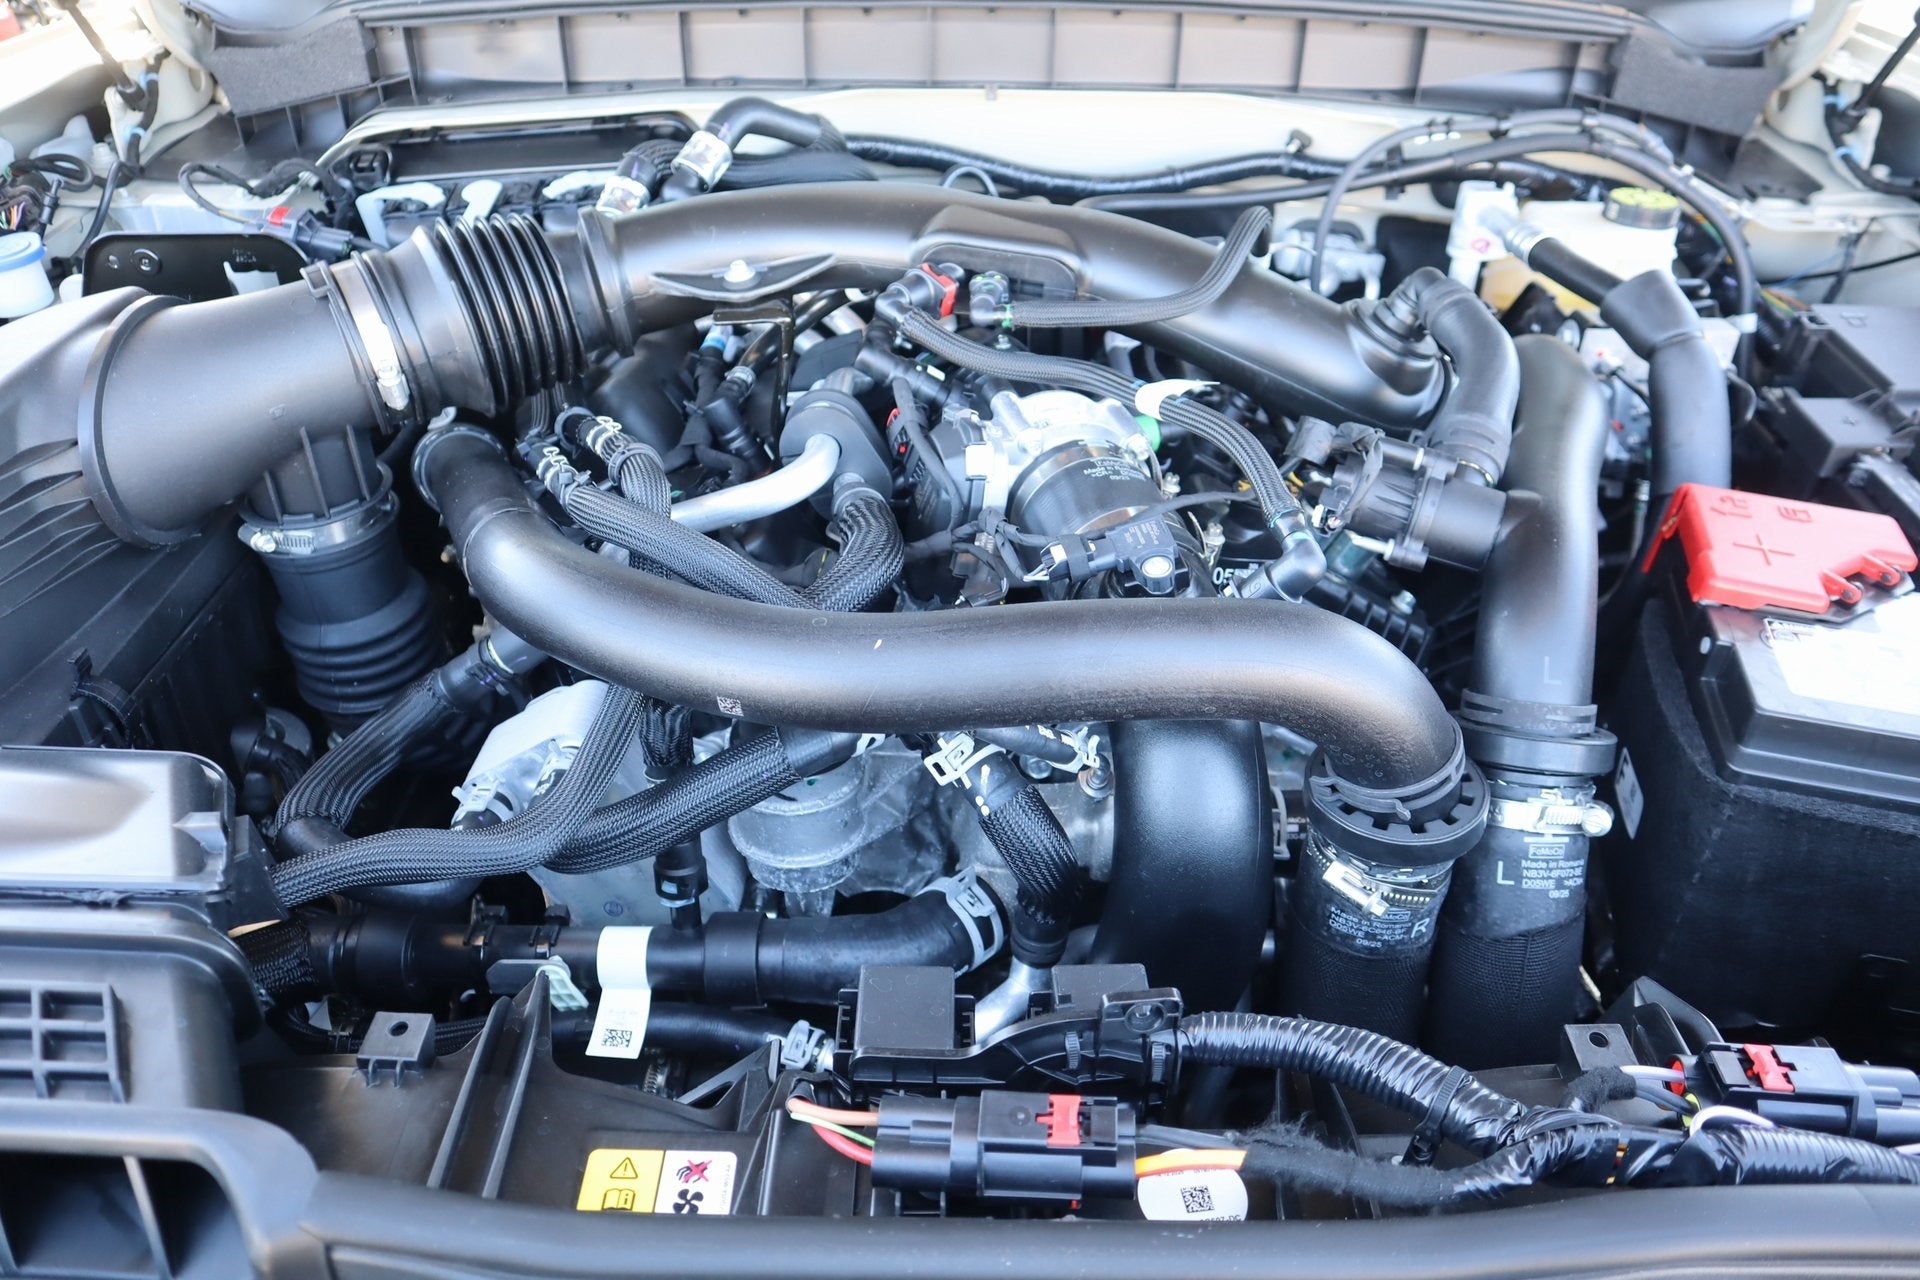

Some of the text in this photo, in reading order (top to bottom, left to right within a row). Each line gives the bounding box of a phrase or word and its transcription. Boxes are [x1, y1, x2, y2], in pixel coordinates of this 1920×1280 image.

[1497, 860, 1515, 885] L
[1521, 860, 1547, 869] Made
[1548, 860, 1557, 868] in
[1329, 918, 1365, 938] D05WE
[1330, 906, 1359, 923] Made
[1373, 922, 1412, 930] Romania
[1410, 917, 1430, 938] R
[1356, 937, 1382, 948] 09/25
